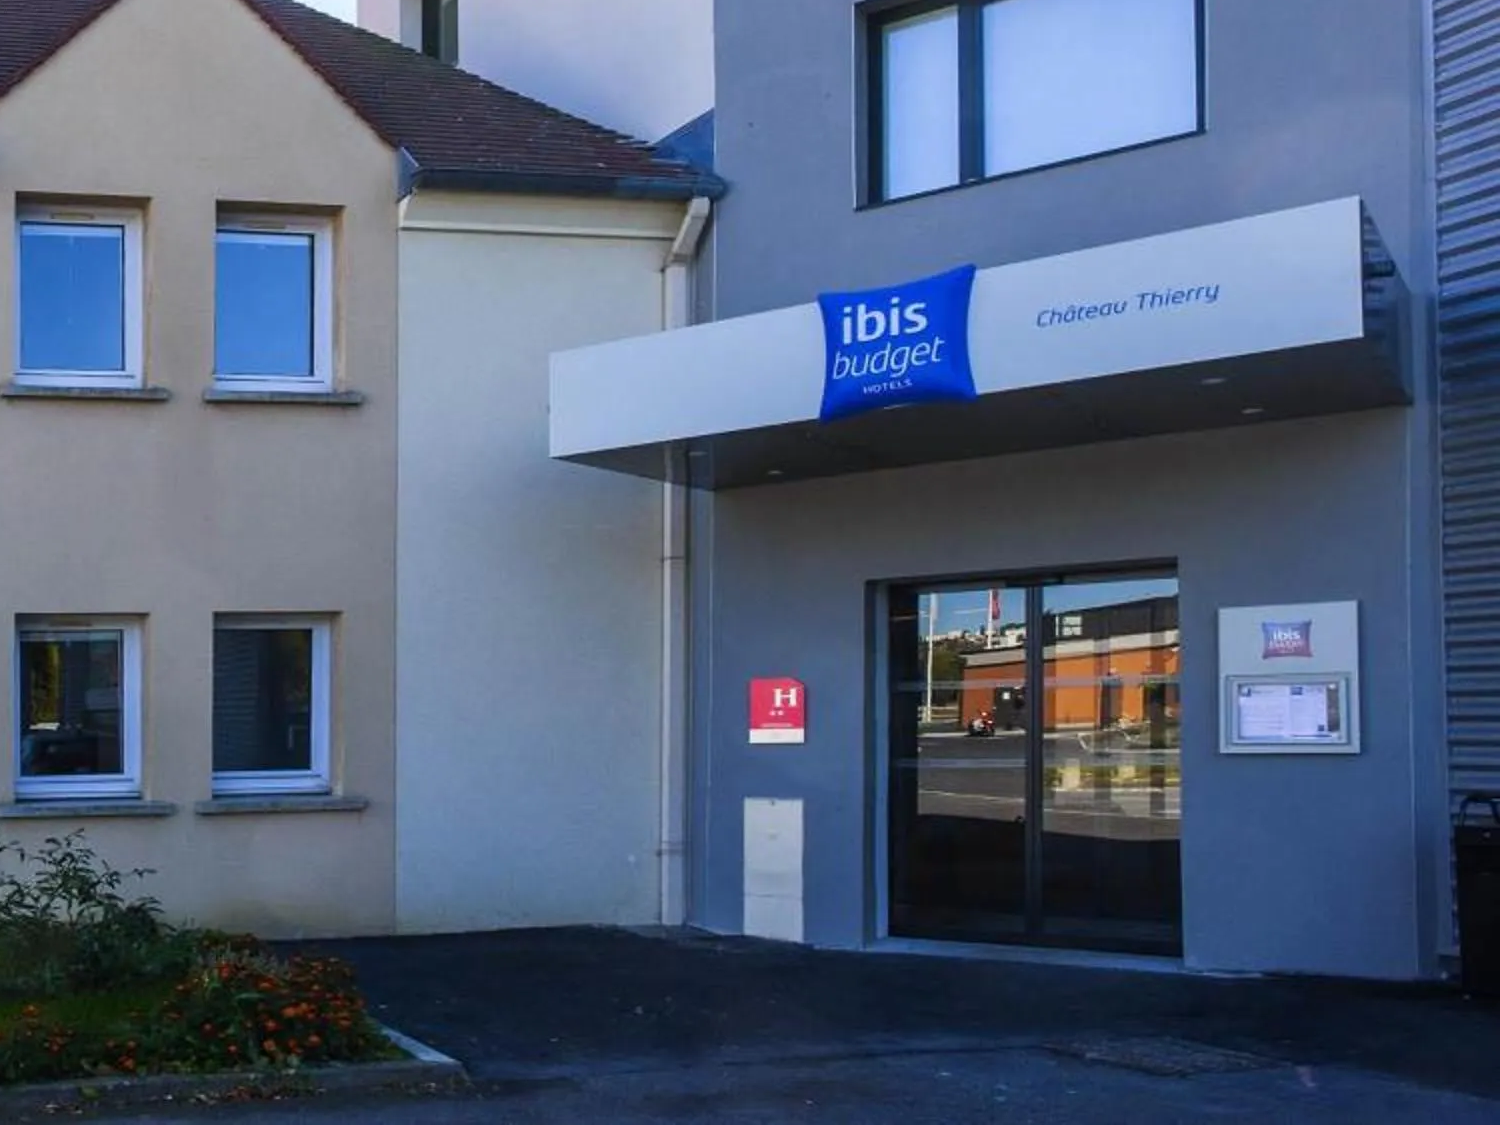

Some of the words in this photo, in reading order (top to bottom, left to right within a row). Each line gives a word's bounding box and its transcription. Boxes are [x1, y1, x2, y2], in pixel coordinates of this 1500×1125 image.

[843, 296, 928, 345] ibis
[1036, 300, 1128, 328] Château
[1136, 284, 1220, 311] Thierry
[833, 336, 945, 380] budget
[773, 688, 798, 707] H
